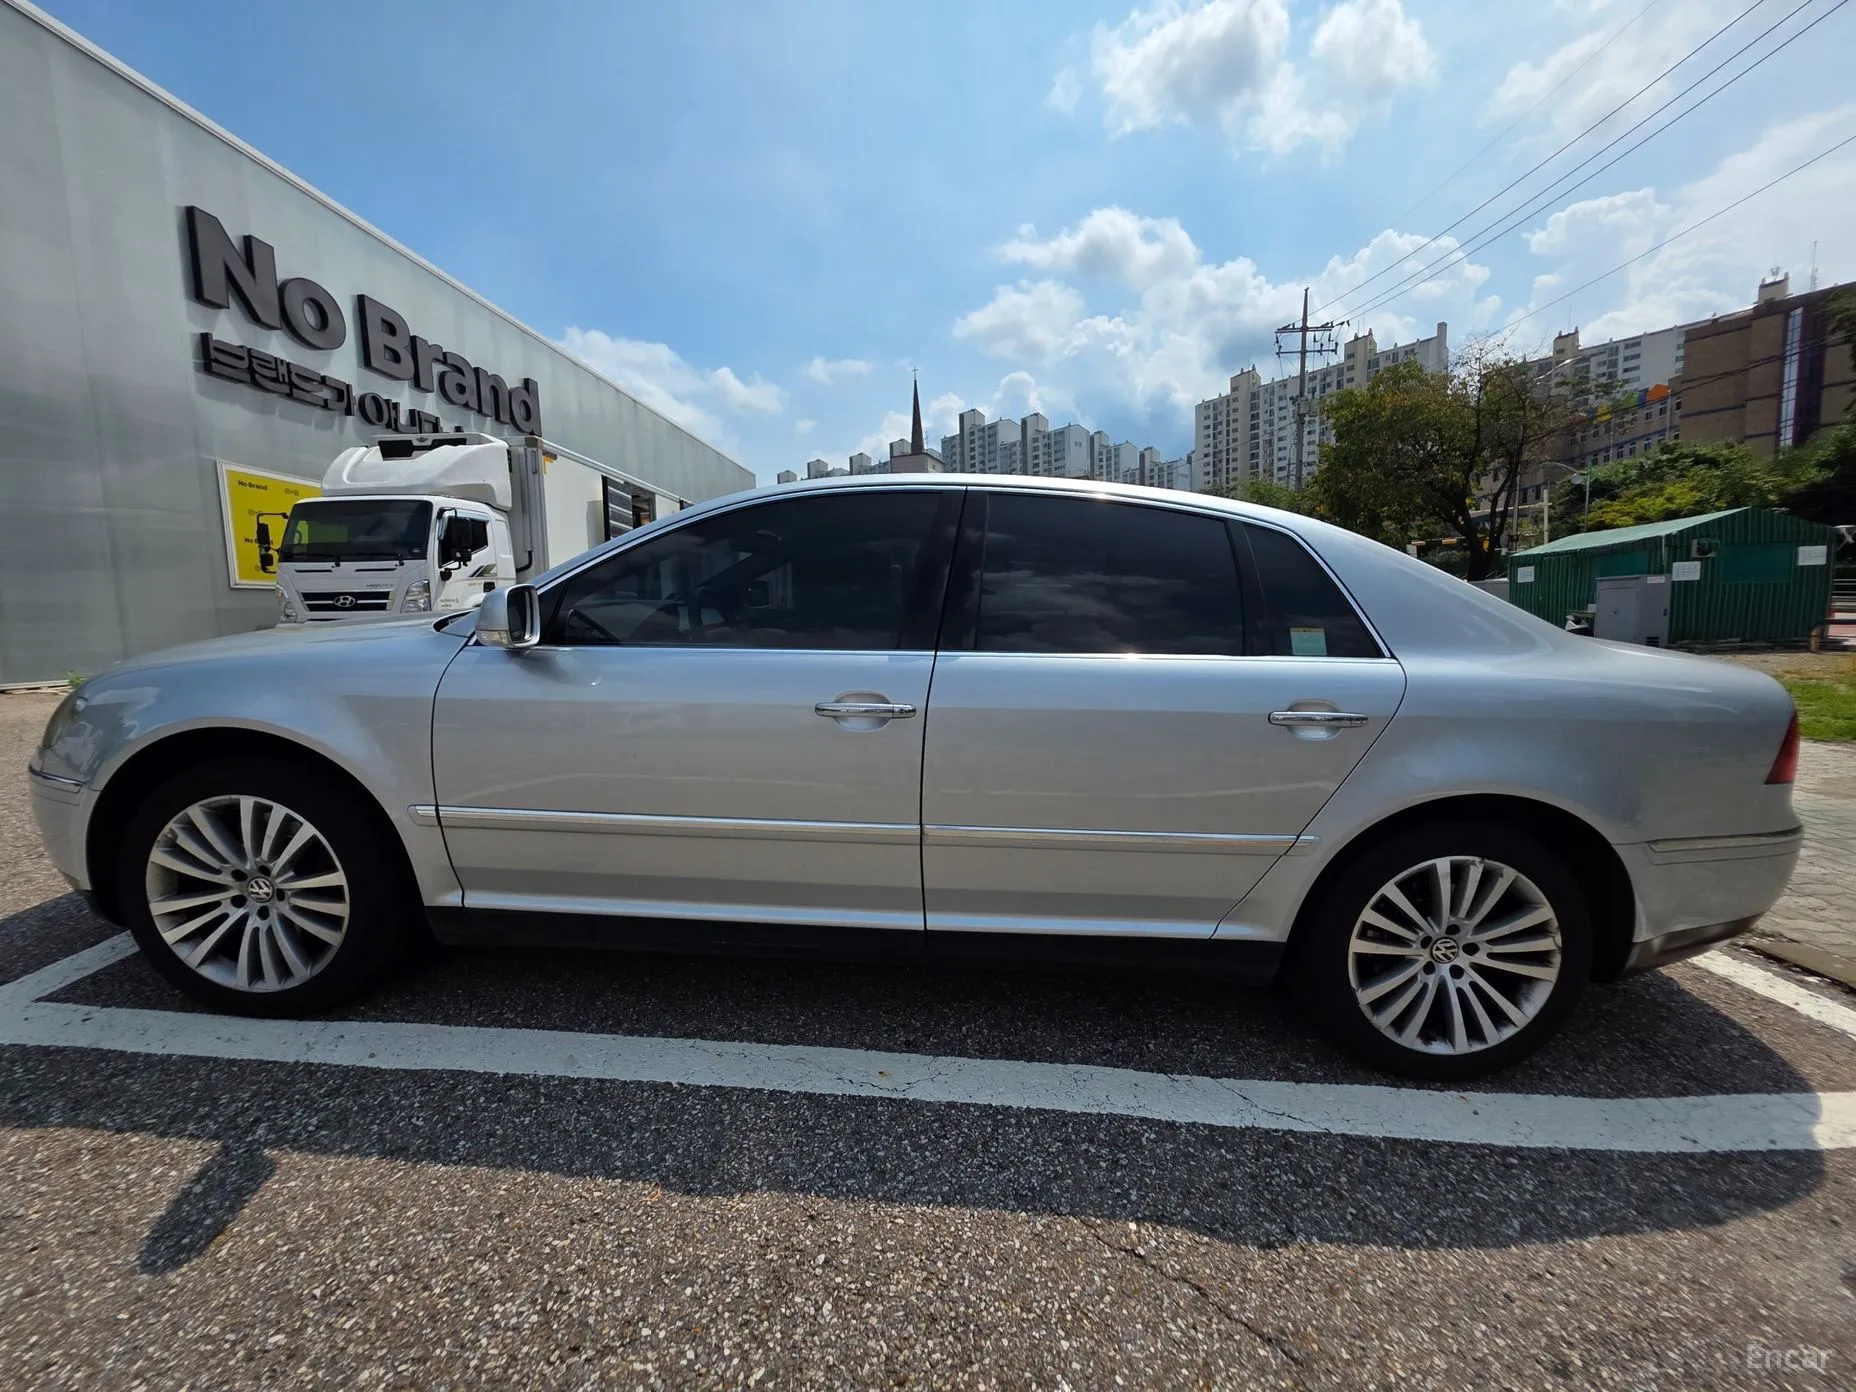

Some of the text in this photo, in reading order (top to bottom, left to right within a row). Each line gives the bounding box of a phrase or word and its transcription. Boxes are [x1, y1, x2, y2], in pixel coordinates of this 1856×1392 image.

[186, 205, 542, 437] No Brand
[200, 332, 355, 416] 브랜드가
